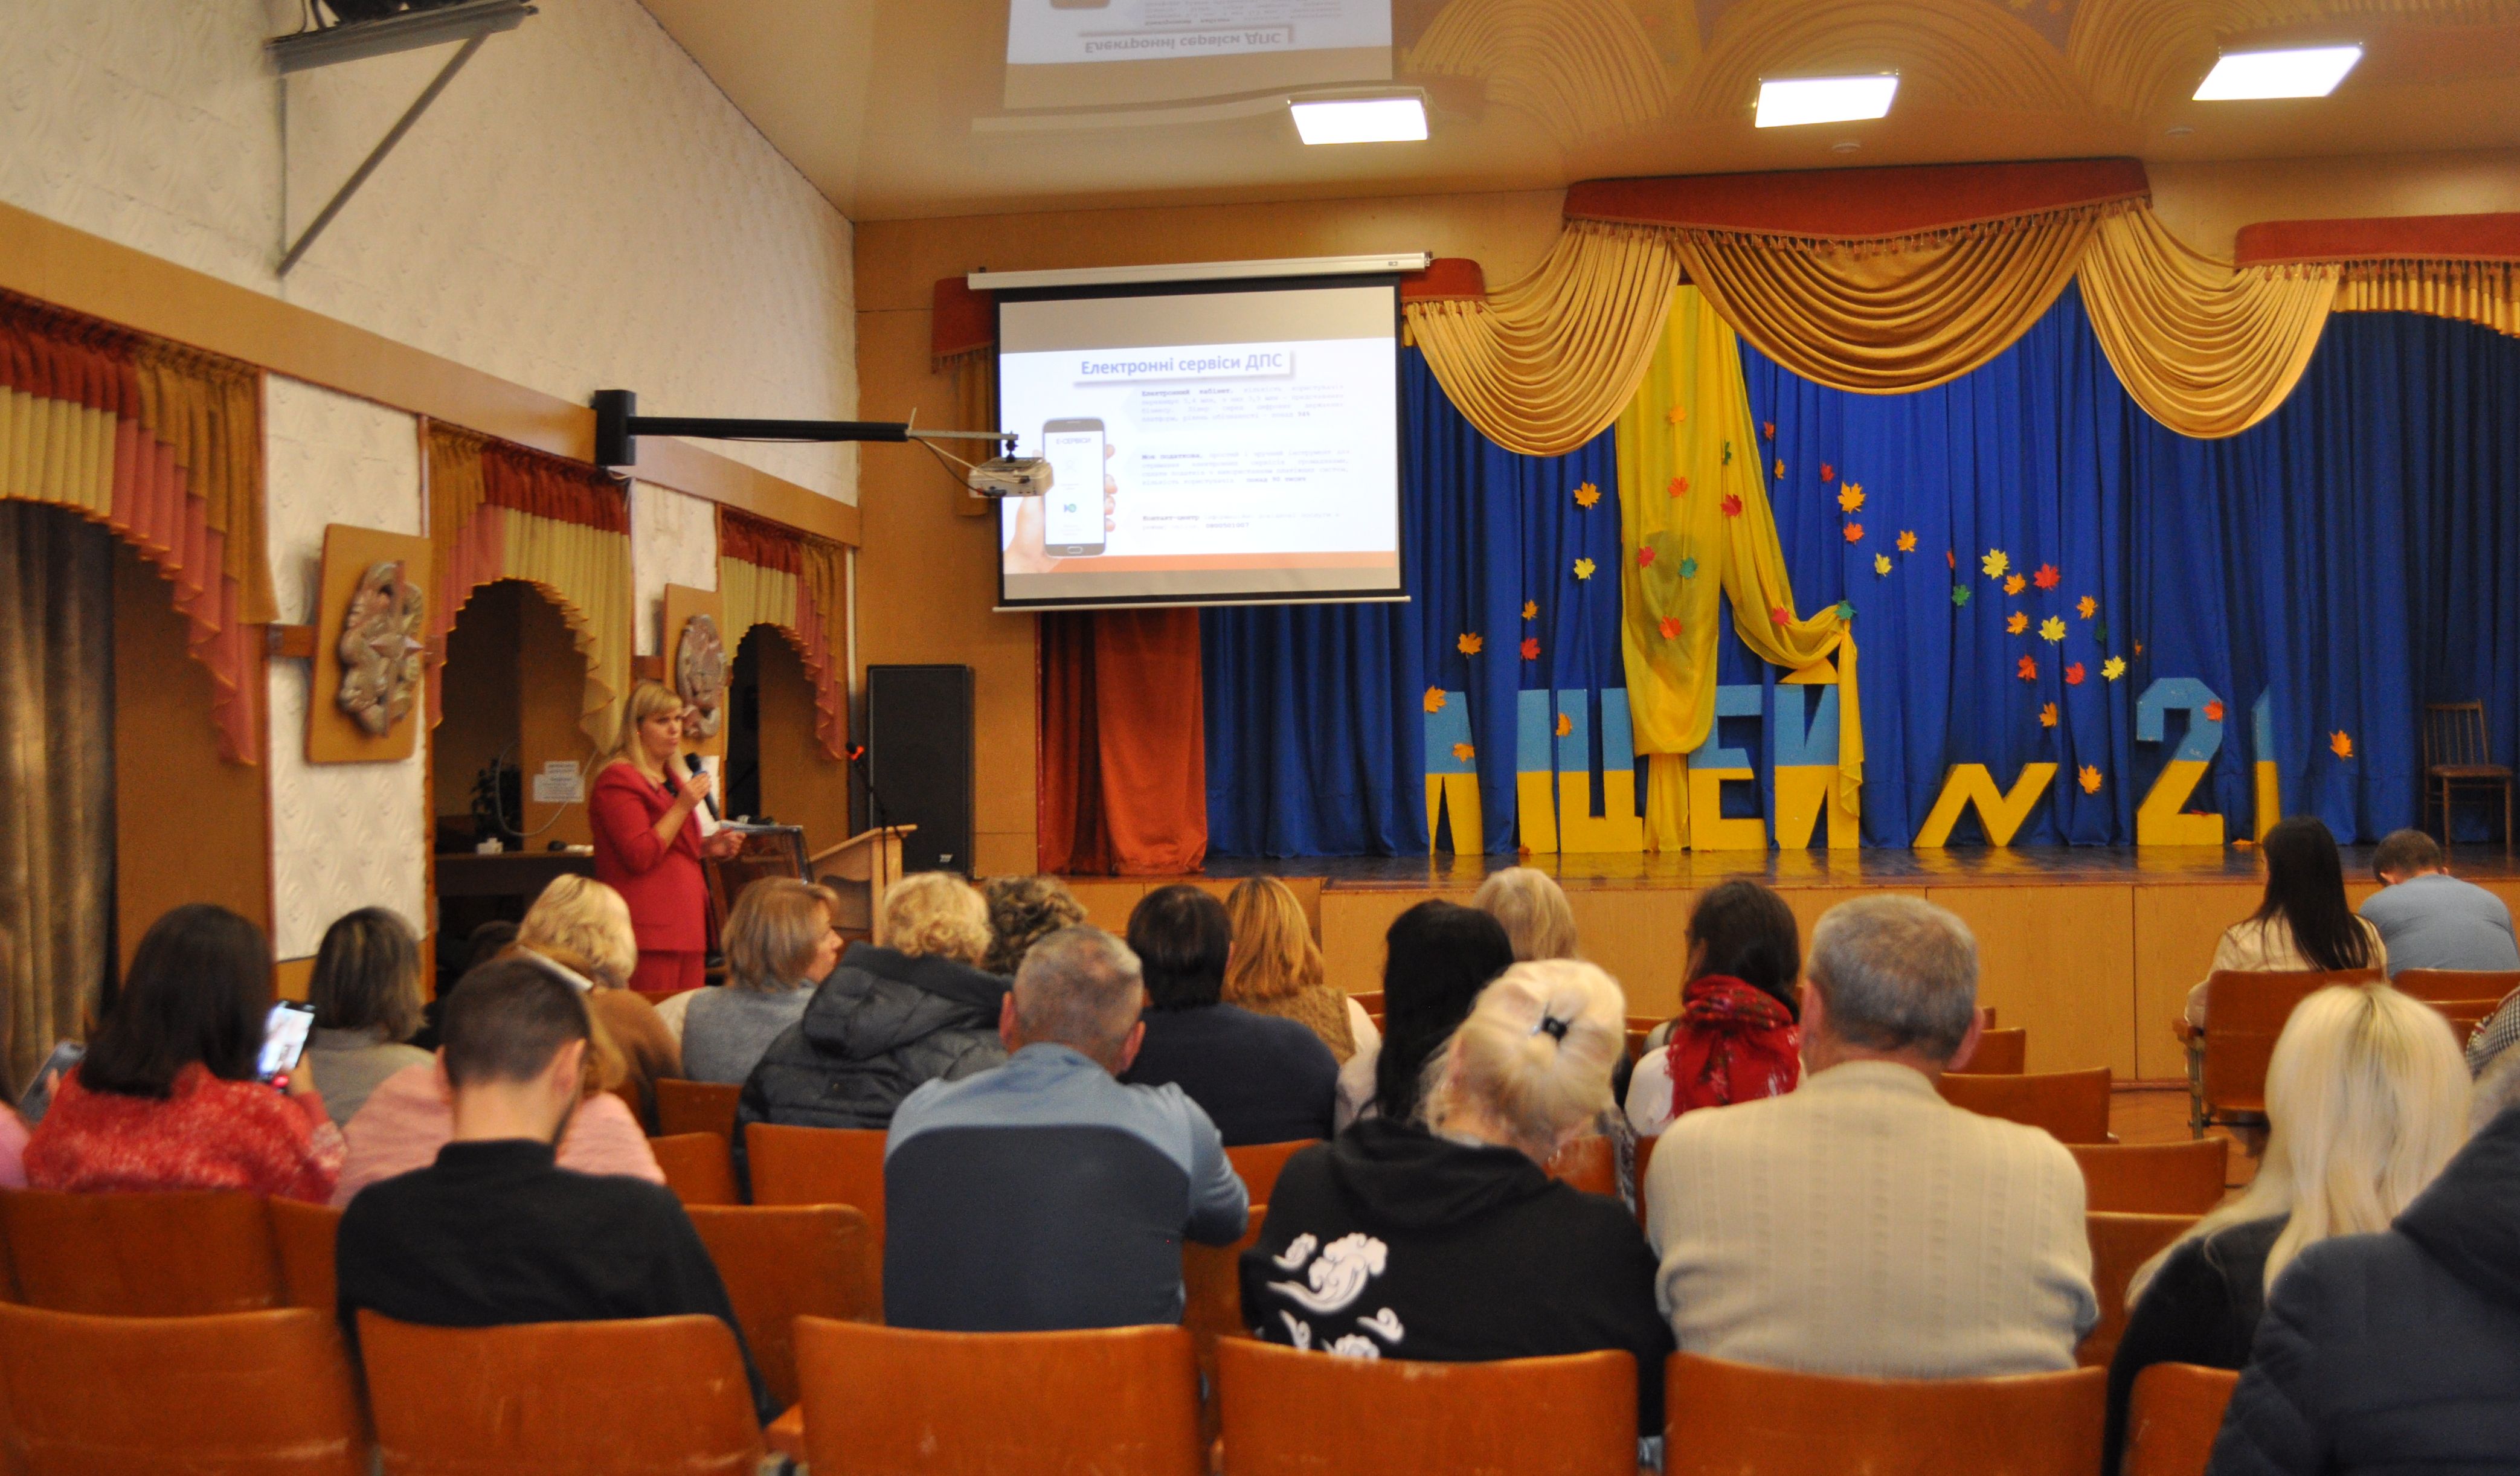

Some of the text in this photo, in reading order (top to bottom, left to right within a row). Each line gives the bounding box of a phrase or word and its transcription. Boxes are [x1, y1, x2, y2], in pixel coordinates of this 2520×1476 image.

[1081, 354, 1282, 376] Електронні сервіси ДПС
